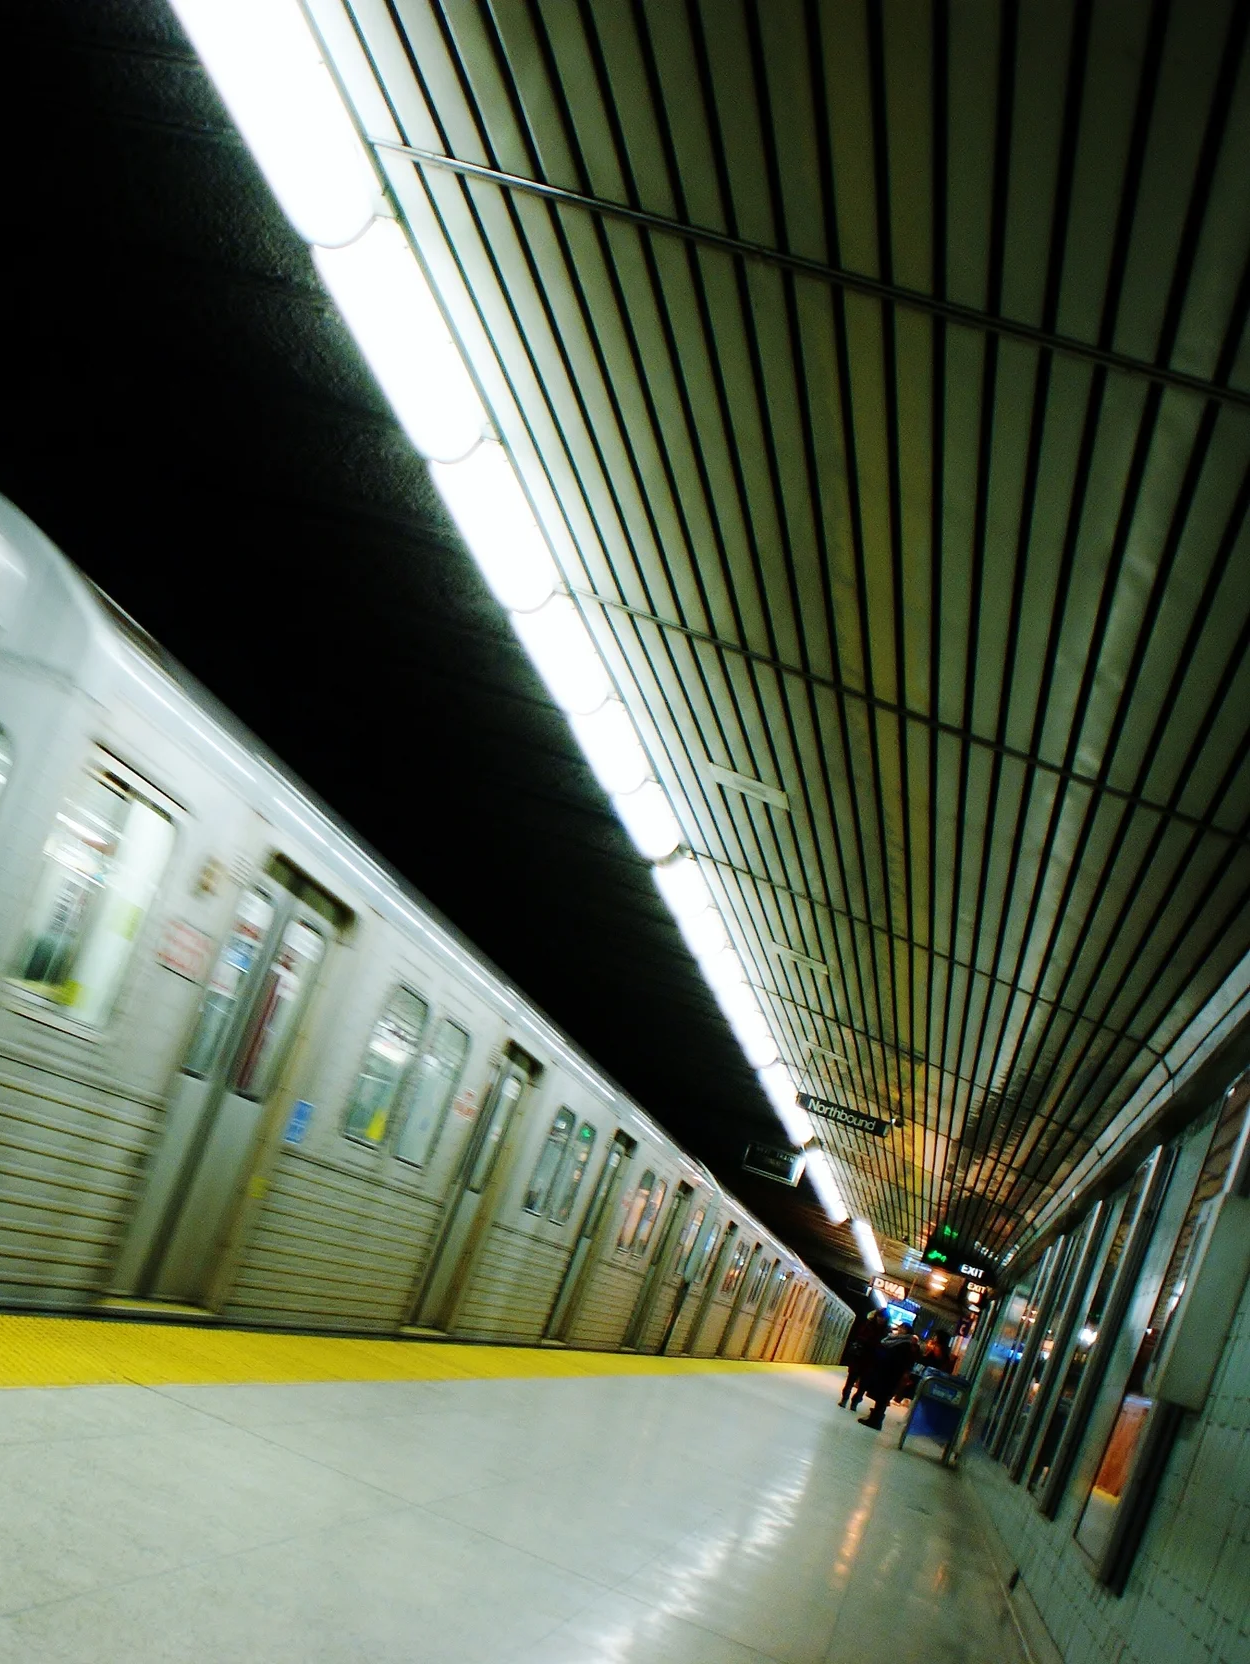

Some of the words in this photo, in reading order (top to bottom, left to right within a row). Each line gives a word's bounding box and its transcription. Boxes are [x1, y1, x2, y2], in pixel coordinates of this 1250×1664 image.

[807, 1098, 876, 1131] Northbound
[960, 1263, 985, 1279] EXIT
[967, 1281, 986, 1294] EXIT
